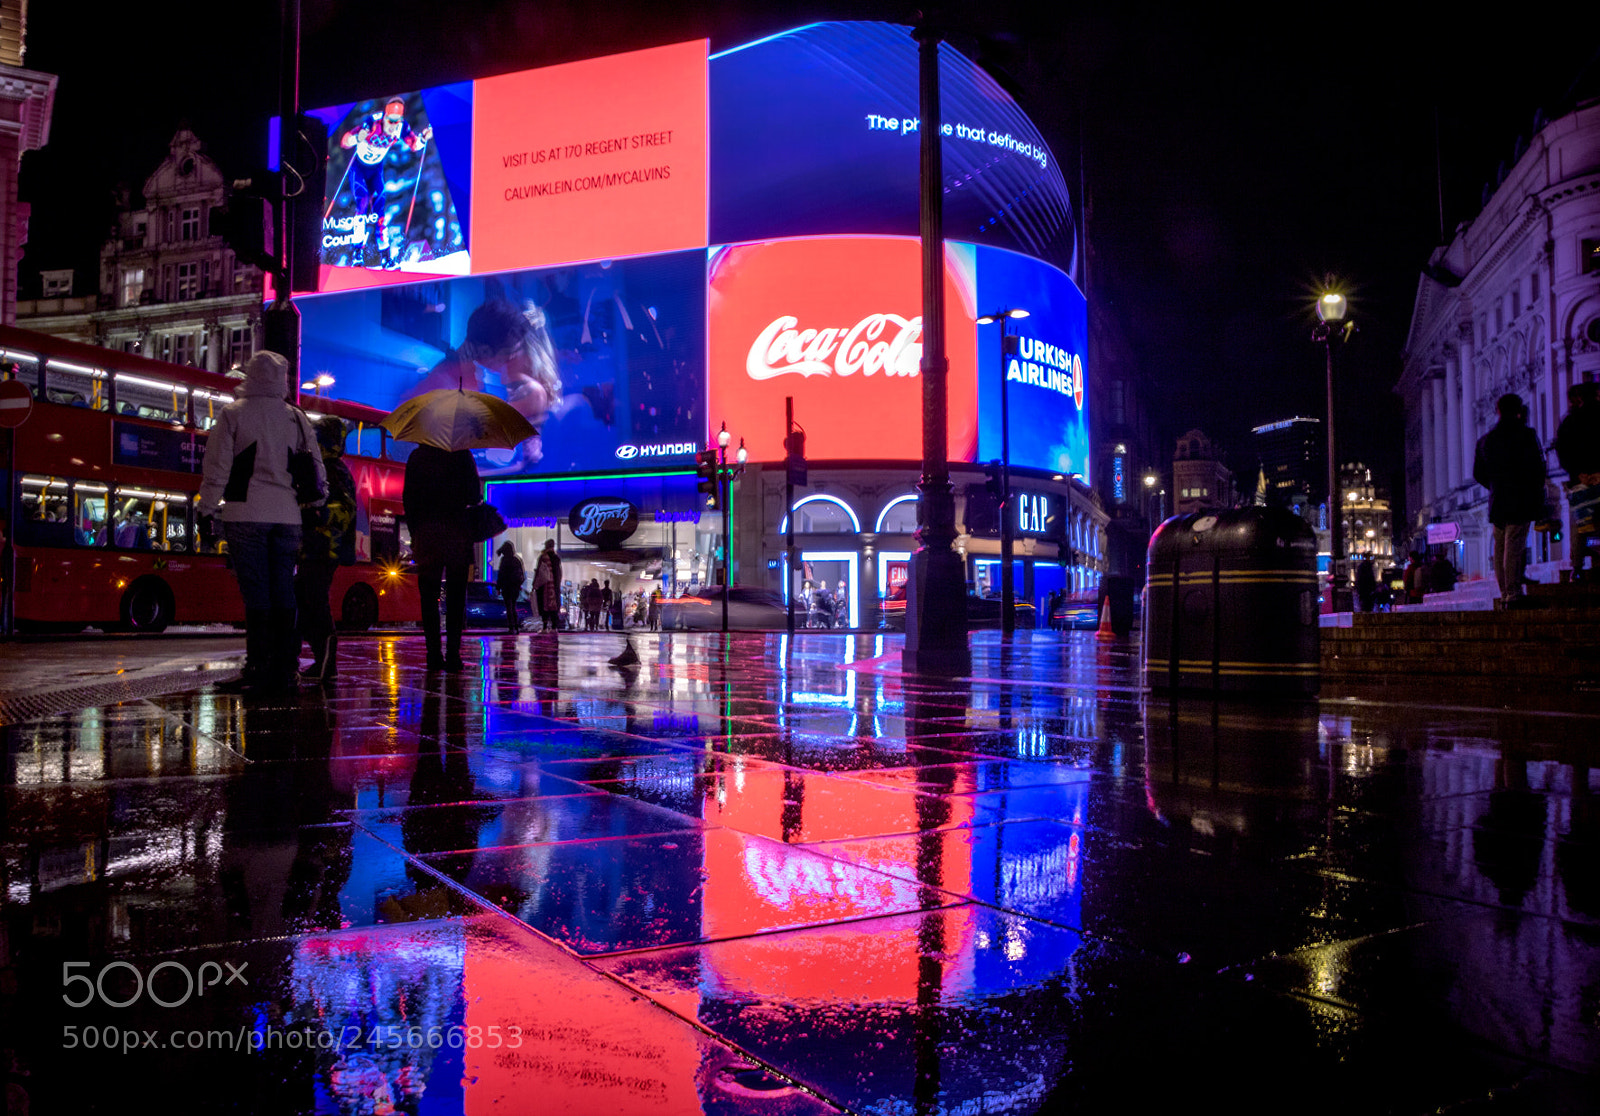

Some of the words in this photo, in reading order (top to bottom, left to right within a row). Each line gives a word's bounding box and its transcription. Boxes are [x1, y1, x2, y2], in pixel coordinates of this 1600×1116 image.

[502, 152, 528, 169] VISIT
[531, 149, 546, 164] US
[548, 147, 562, 162] AT
[564, 144, 583, 159] 170
[585, 137, 629, 156] REGENT
[631, 130, 674, 149] STREET
[865, 114, 899, 131] The
[901, 117, 954, 136] phe
[955, 122, 986, 143] that
[988, 131, 1032, 157] defined
[1032, 145, 1048, 170] big
[504, 165, 671, 202] CALVINKLEIN.COM/MYCALVINS
[746, 313, 924, 381] Coca-Cola
[1018, 335, 1073, 374] URKISH
[1006, 358, 1074, 398] AIRLINES
[639, 442, 697, 458] HYUNDAI
[356, 463, 391, 498] AY
[503, 514, 558, 529] harmacy
[574, 501, 632, 537] Boots
[654, 508, 702, 525] beauty
[1019, 493, 1049, 533] GAP
[891, 566, 909, 580] FIN
